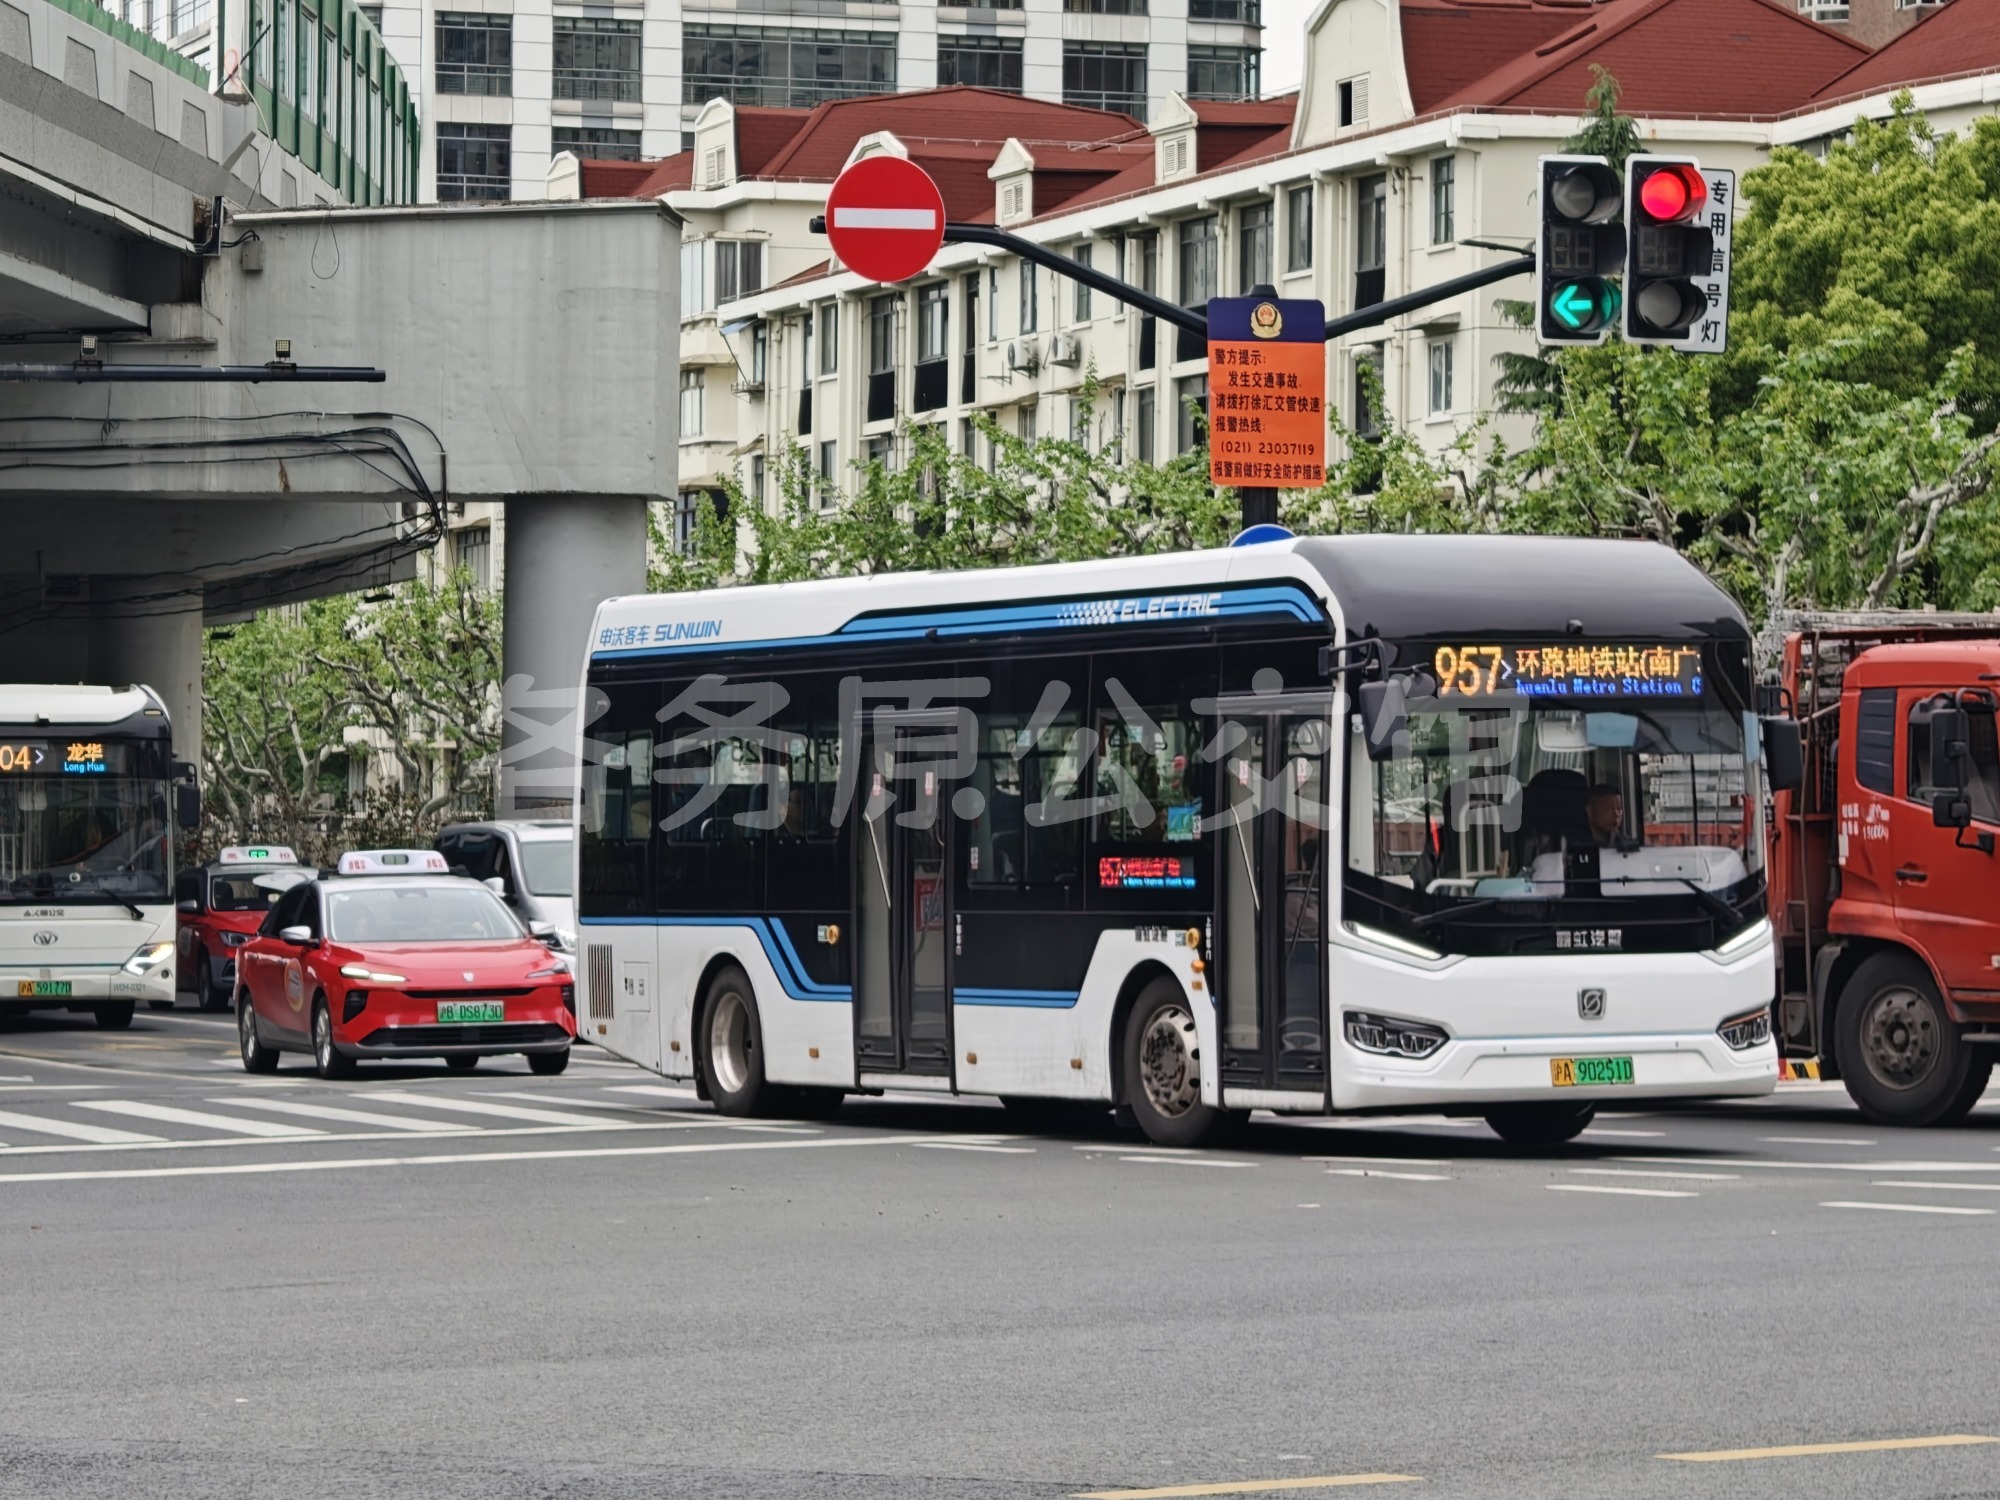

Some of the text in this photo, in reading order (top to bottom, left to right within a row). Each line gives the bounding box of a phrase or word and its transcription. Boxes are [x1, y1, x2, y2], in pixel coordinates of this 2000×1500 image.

[1701, 180, 1728, 343] 专用信号灯
[1215, 348, 1266, 366] 警方提示：
[1215, 393, 1321, 413] 请拨打徐汇交管快速
[1215, 415, 1266, 433] 报警热线：
[1220, 440, 1315, 456] (021) 23037119
[1214, 461, 1322, 481] 报警前做好安全防护措施
[1120, 592, 1222, 621] ELECTRIC
[599, 620, 723, 647] 申沃客车 SUNWIN
[1434, 645, 1702, 697] 957 环路地铁站(南广
[1573, 677, 1616, 694] Metro
[1623, 676, 1682, 695] Station
[67, 743, 104, 762] 龙华
[64, 761, 105, 774] Long Hua
